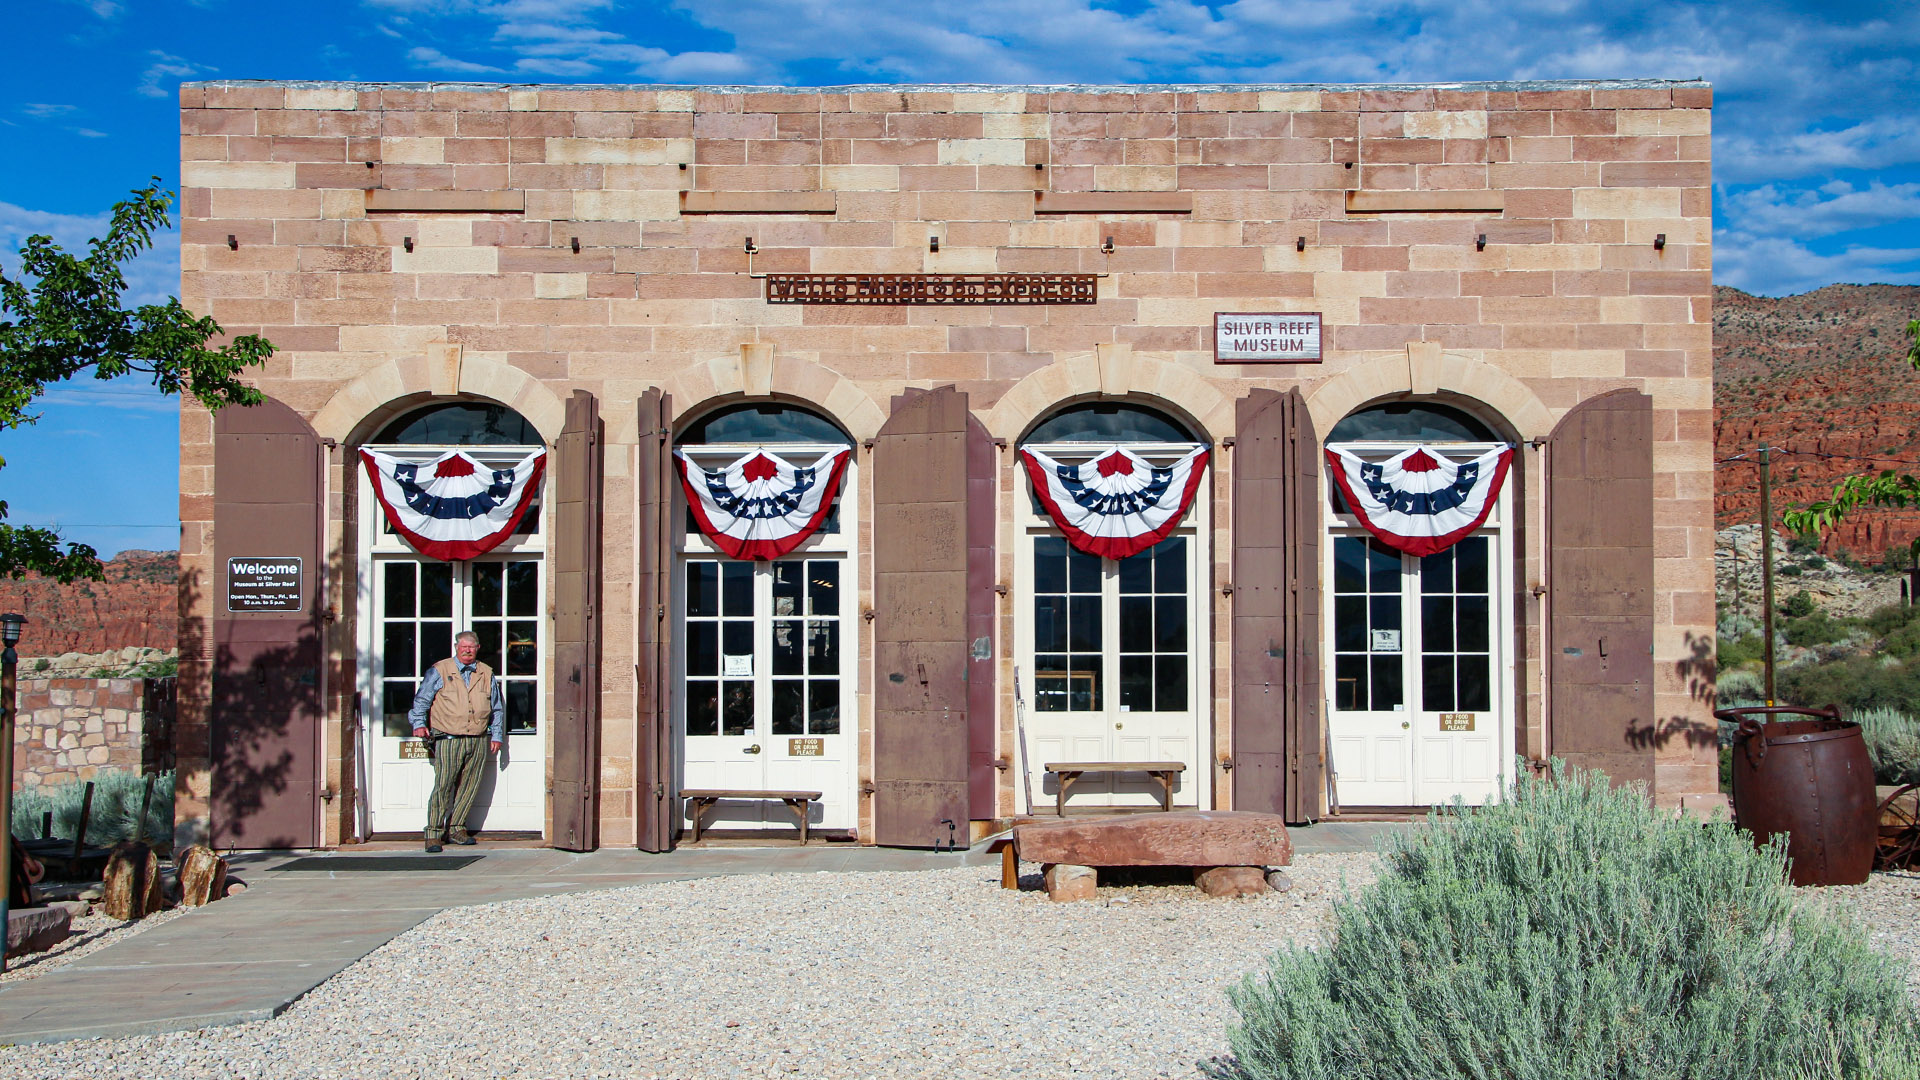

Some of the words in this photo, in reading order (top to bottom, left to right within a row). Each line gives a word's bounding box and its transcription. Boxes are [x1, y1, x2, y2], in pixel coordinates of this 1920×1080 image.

[773, 275, 847, 300] WELLS
[856, 275, 928, 300] FARGO
[932, 275, 948, 300] &
[1224, 321, 1272, 336] SILVER
[1279, 322, 1314, 335] REEF
[1234, 339, 1304, 352] MUSEUM
[232, 563, 298, 575] Welcome
